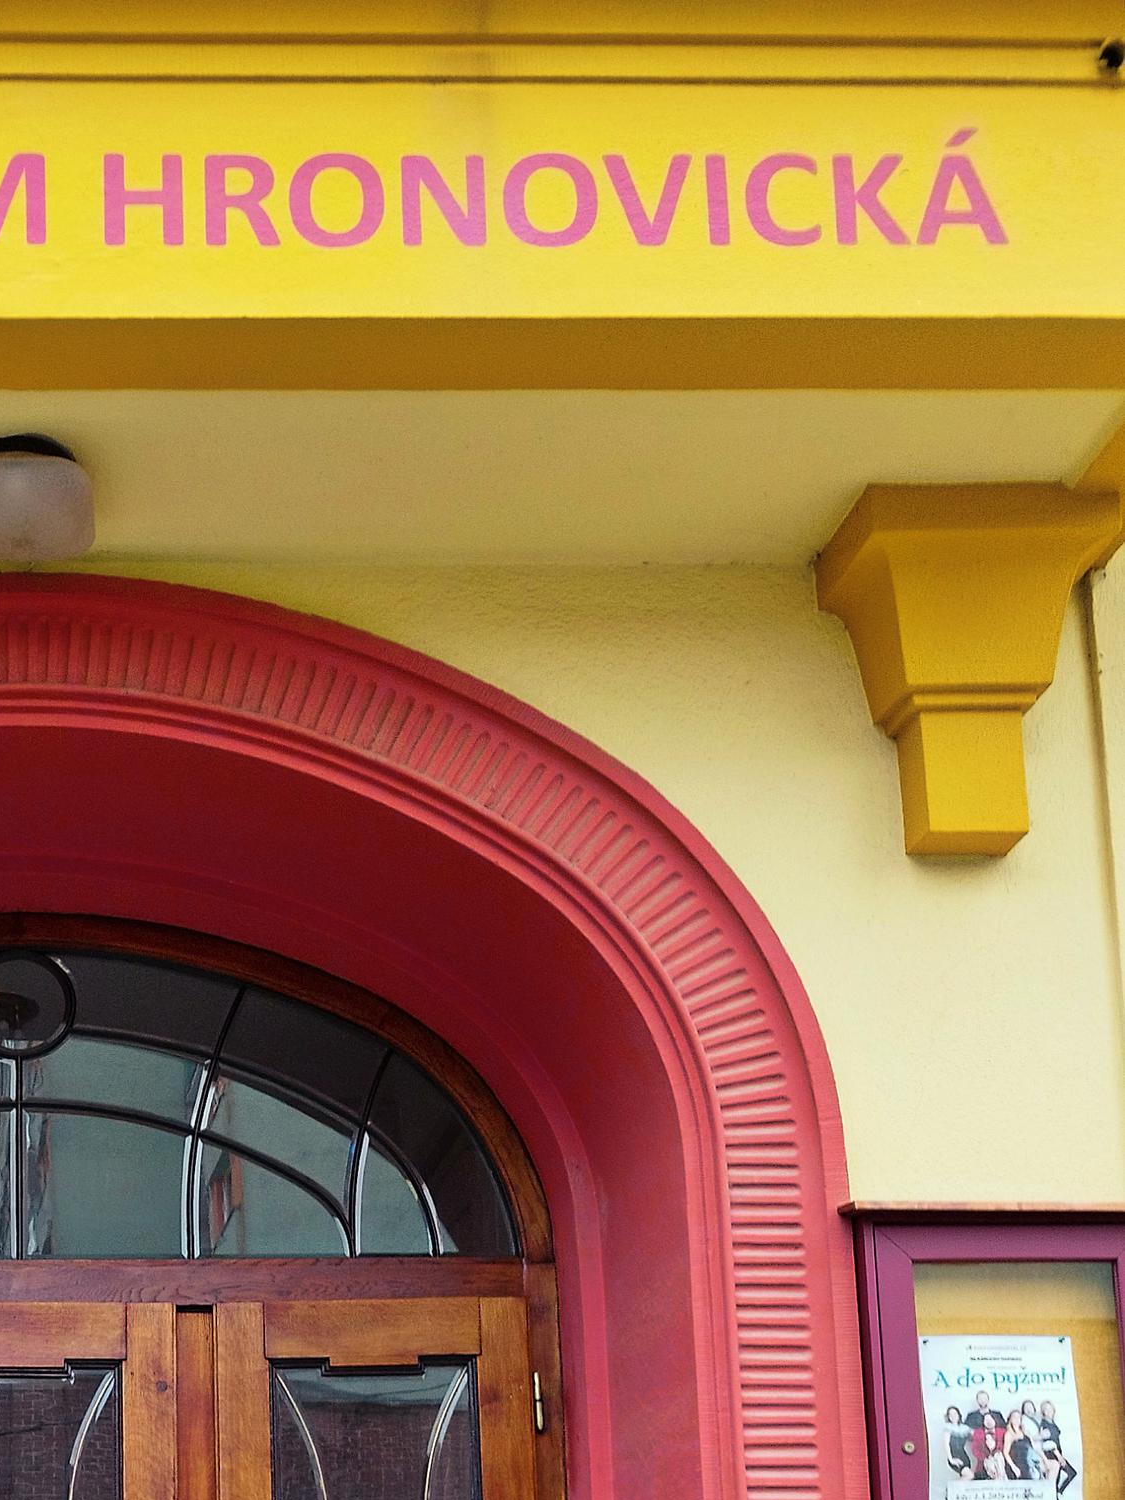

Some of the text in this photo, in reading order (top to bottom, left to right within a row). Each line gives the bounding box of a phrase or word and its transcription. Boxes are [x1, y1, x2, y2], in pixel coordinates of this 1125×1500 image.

[104, 127, 1008, 247] HRONOVICKÁ
[933, 1366, 1066, 1393] A do pyžam!
